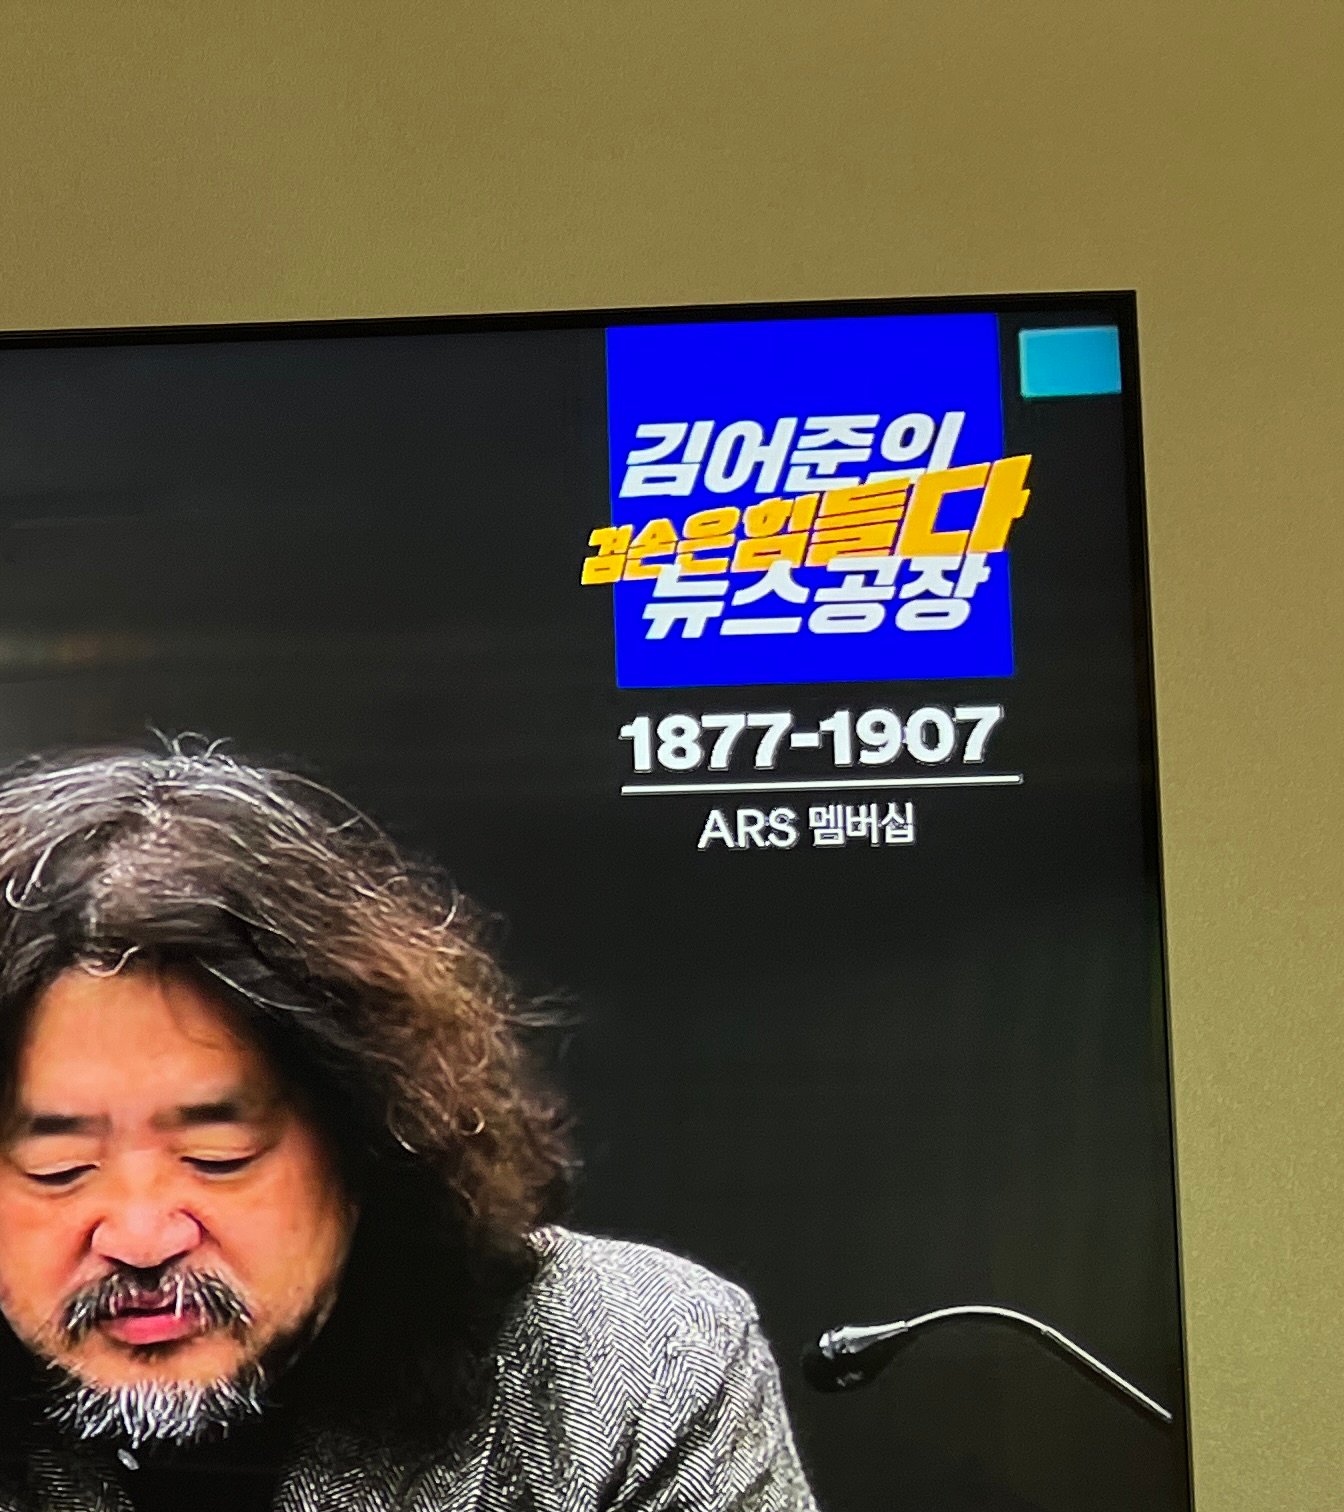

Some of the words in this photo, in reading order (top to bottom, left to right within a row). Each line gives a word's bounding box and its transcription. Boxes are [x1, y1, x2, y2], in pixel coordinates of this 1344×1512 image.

[618, 411, 965, 499] 김어준의
[640, 553, 990, 640] 뉴스공장
[618, 704, 1004, 772] 1877-1907
[696, 808, 798, 850] ARS
[808, 802, 916, 846] 멤버십
